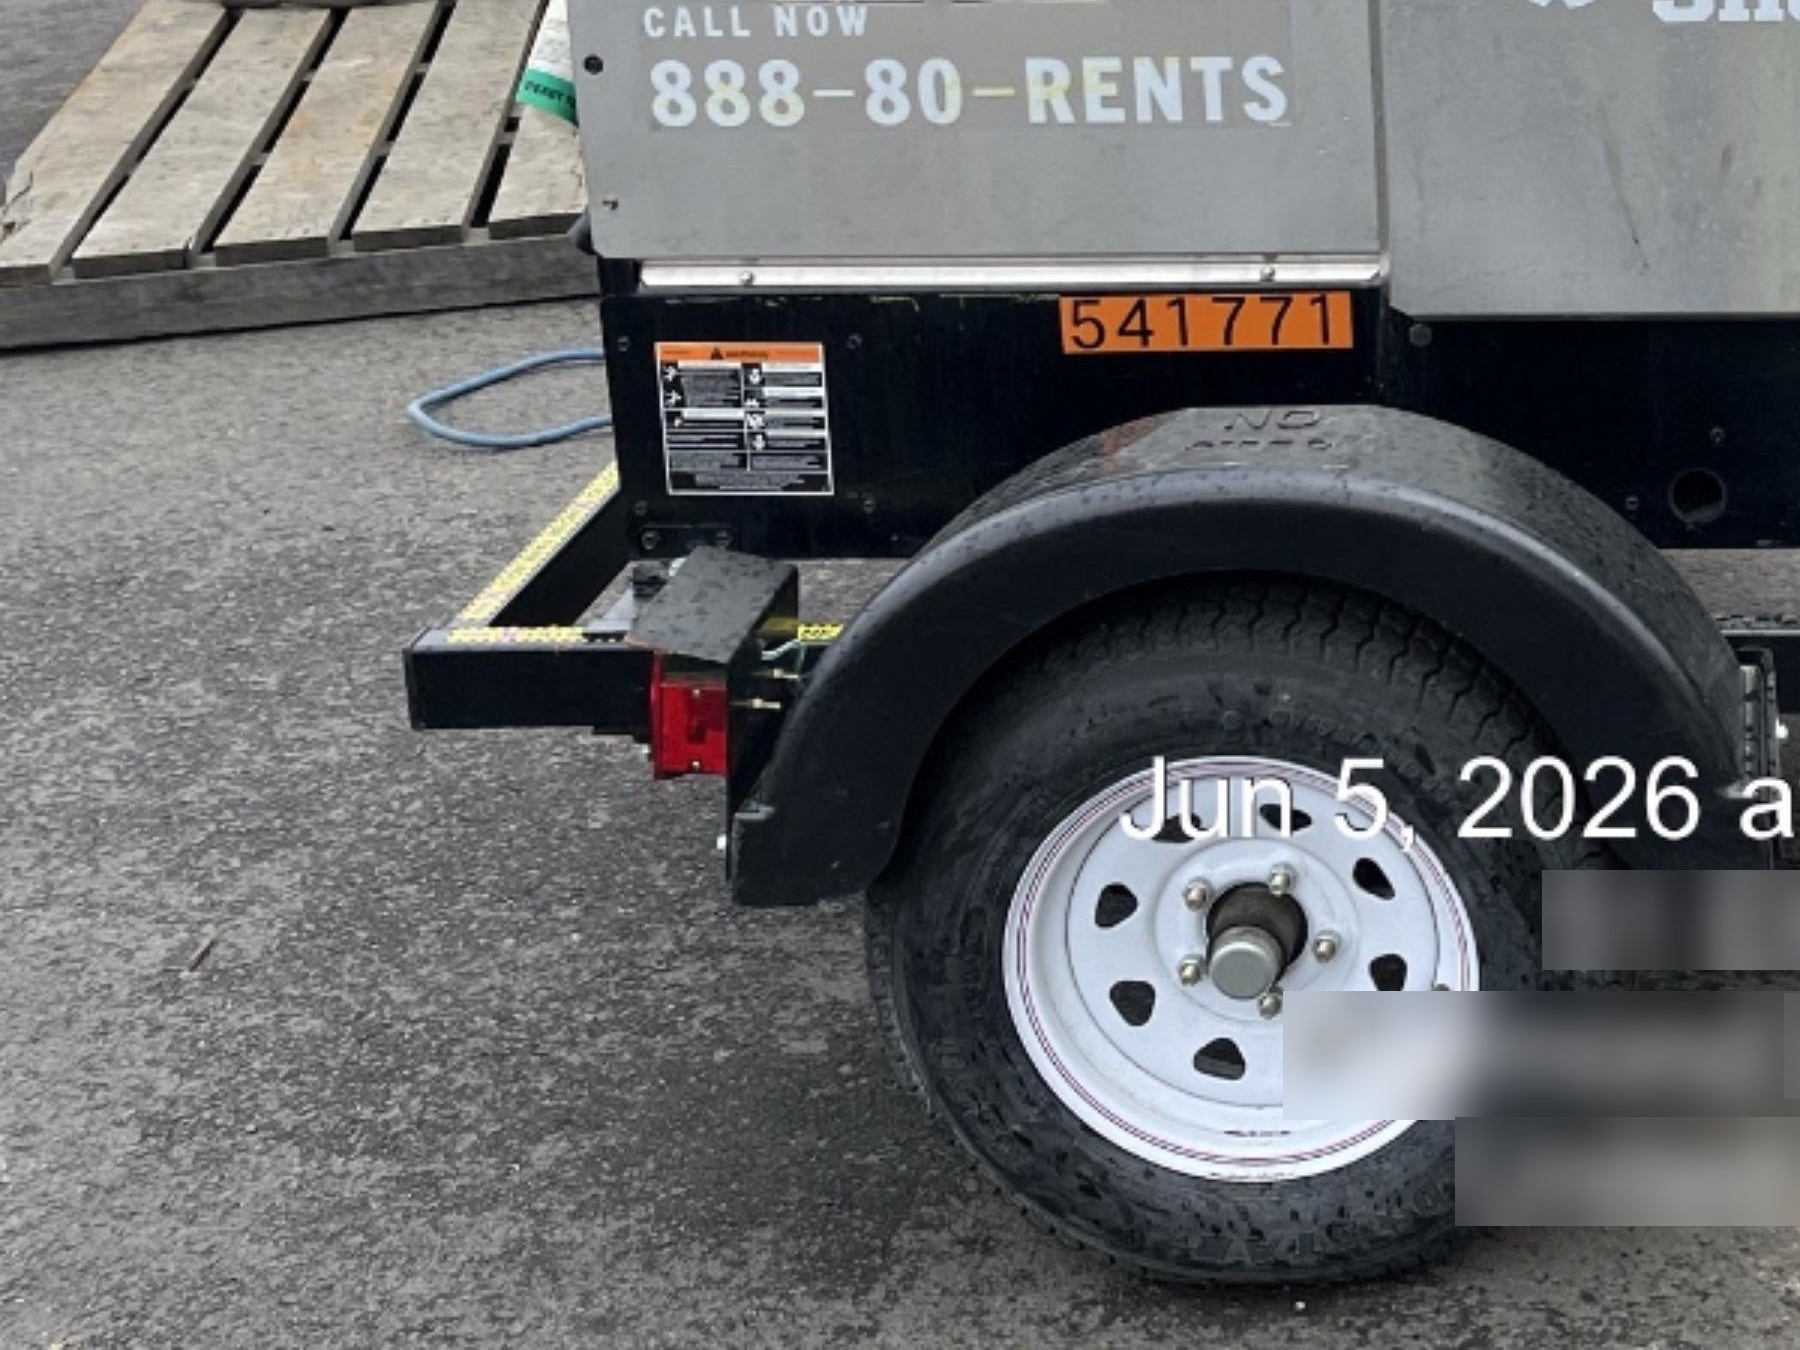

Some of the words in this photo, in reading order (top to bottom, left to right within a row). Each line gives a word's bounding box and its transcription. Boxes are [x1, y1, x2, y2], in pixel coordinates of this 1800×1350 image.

[644, 5, 751, 38] CALL
[773, 5, 870, 37] NOW
[1071, 294, 1331, 349] 541771
